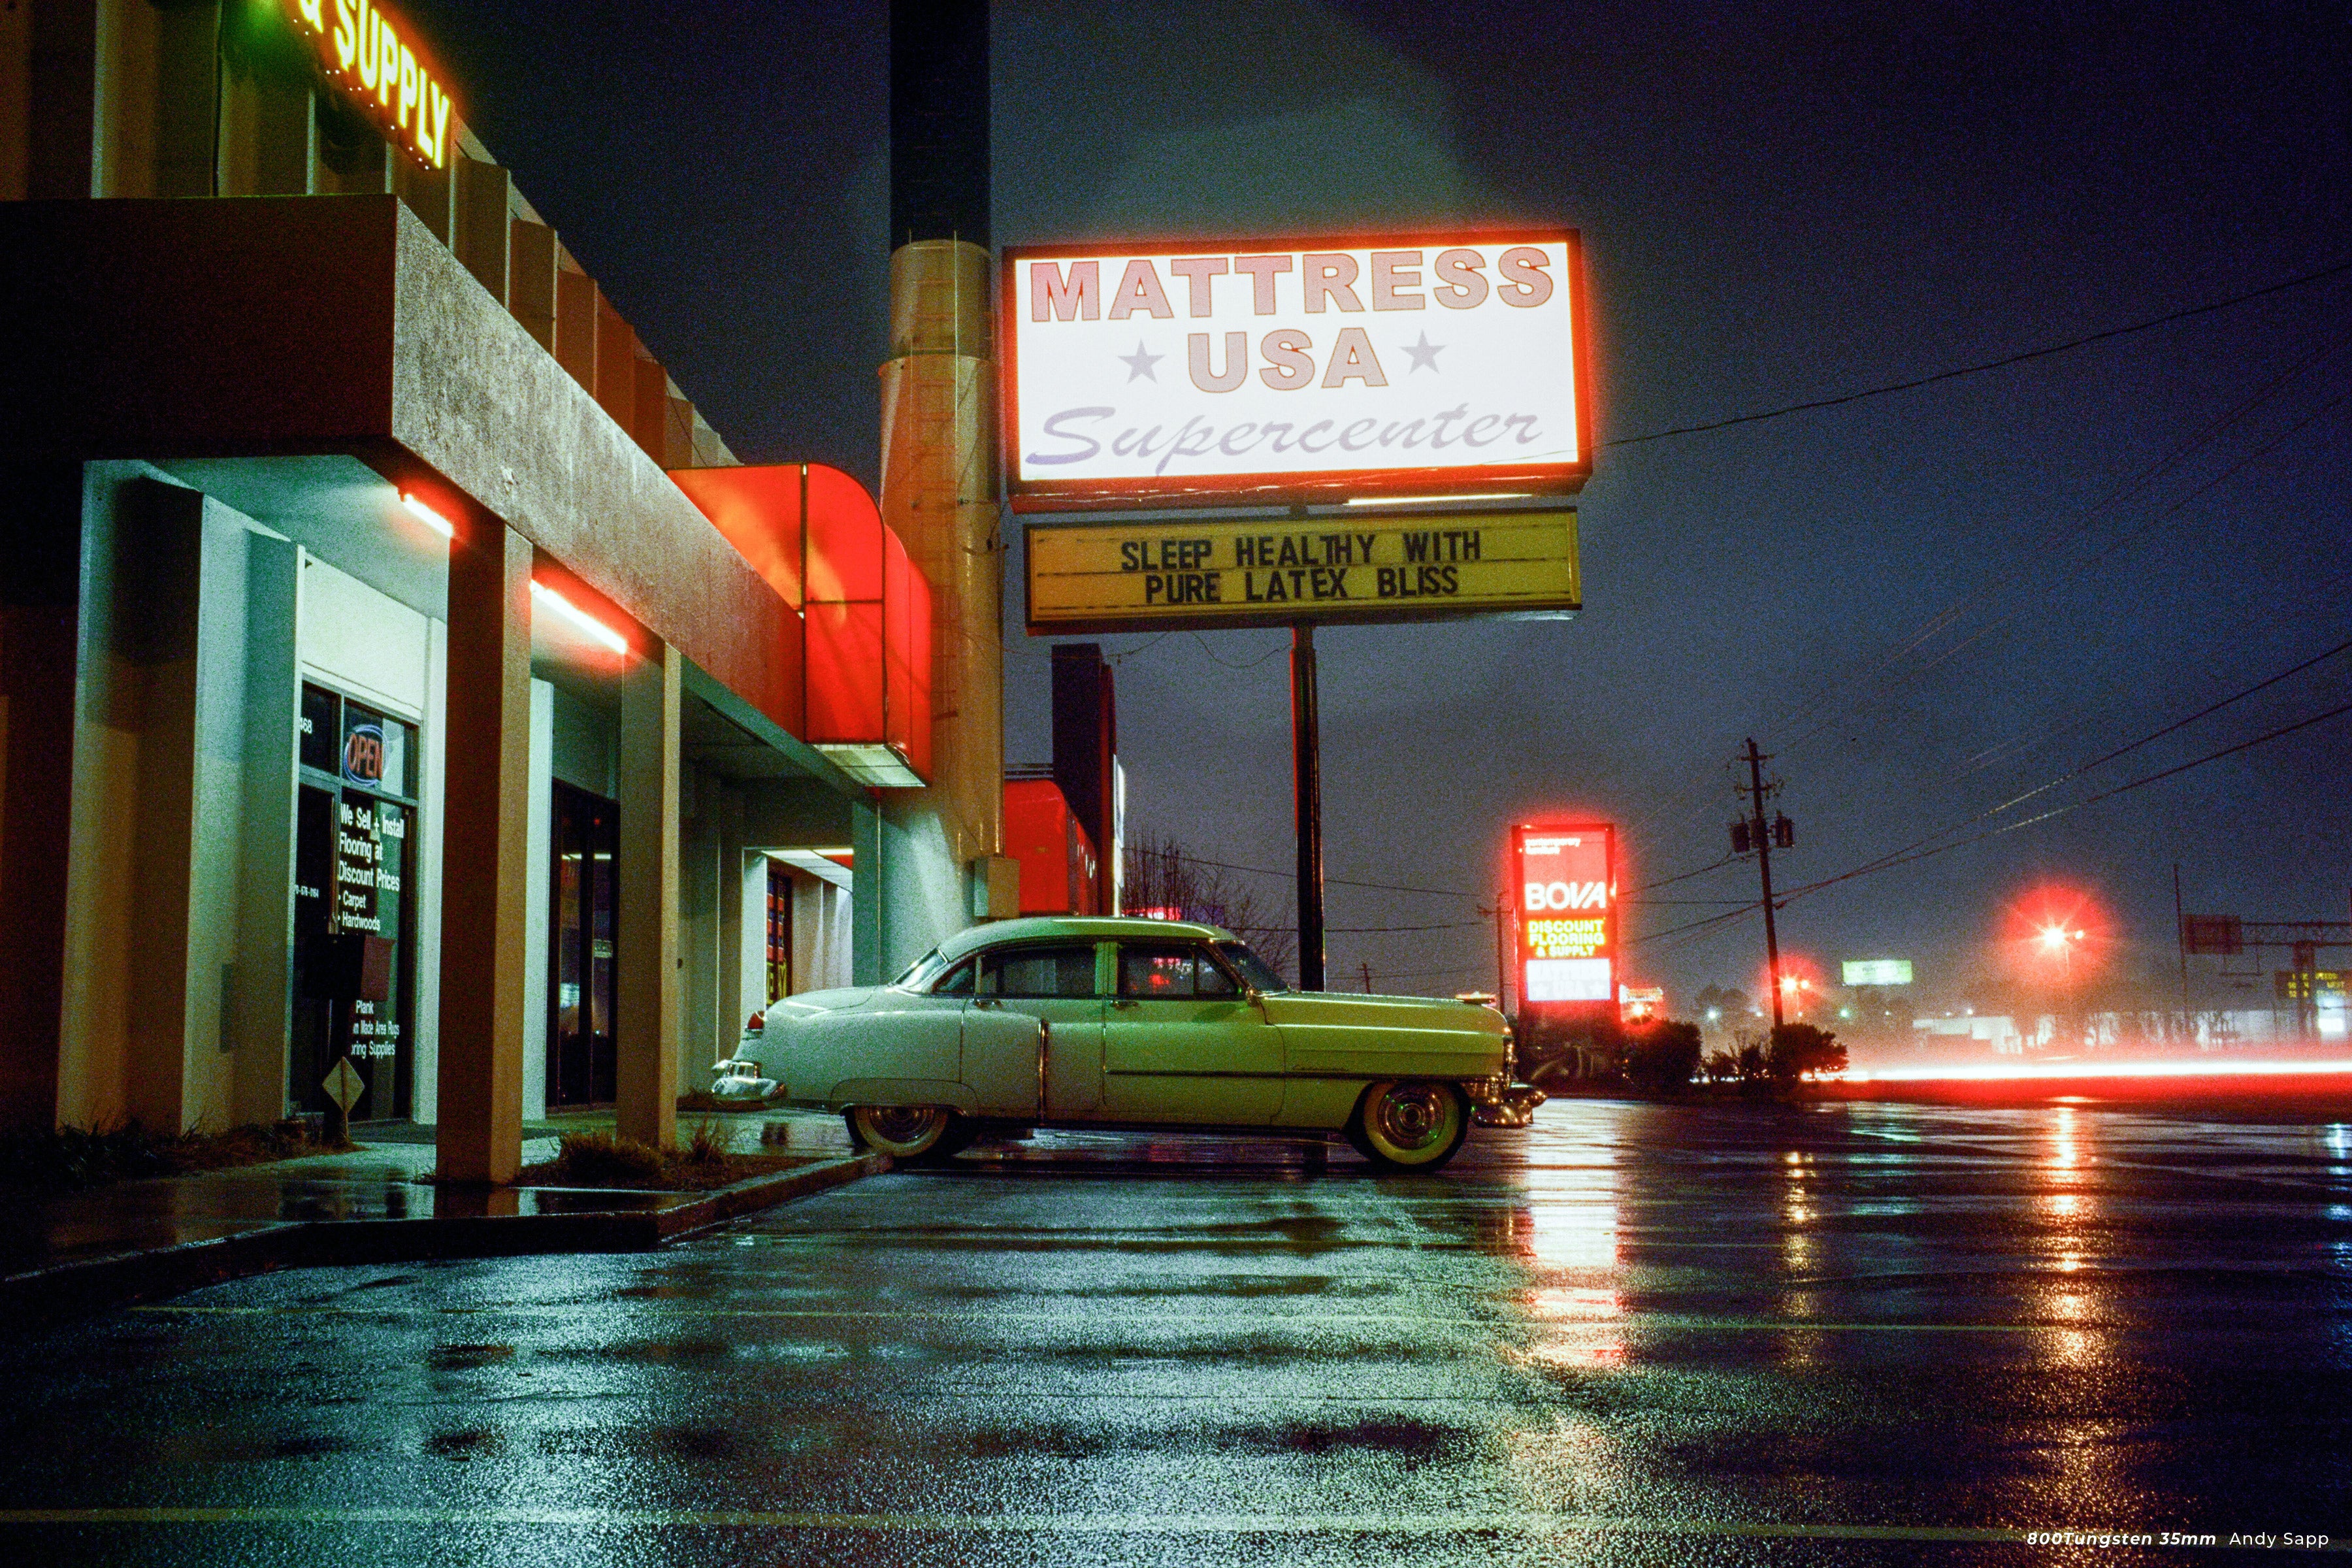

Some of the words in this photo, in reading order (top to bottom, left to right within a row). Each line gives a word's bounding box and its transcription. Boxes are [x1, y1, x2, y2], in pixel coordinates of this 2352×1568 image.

[1030, 246, 1555, 323] MATTRESS
[1187, 327, 1389, 393] USA
[1025, 402, 1543, 476] Supercenter
[1120, 540, 1212, 571] SLEEP
[1235, 533, 1375, 567] HEALTHY
[1403, 530, 1481, 563] WITH
[1145, 572, 1221, 604] PURE
[1245, 566, 1348, 602] LATEX
[1377, 565, 1458, 599] BLISS
[348, 732, 382, 779] OPEN
[340, 802, 353, 826] We
[356, 807, 372, 830] Sell
[382, 813, 404, 839] Install
[340, 831, 372, 864] Flooring
[374, 841, 383, 861] at
[338, 859, 374, 887] Discount
[376, 868, 400, 892] Prices
[343, 890, 367, 911] Carpet
[1525, 881, 1607, 911] BOVA
[342, 911, 381, 932] Hardwoods
[1529, 932, 1605, 947] FLOORING
[356, 1000, 374, 1015] Plank
[361, 1019, 374, 1035] Made
[375, 1021, 387, 1036] Area
[388, 1021, 400, 1039] Rugs
[368, 1040, 396, 1060] Supplies
